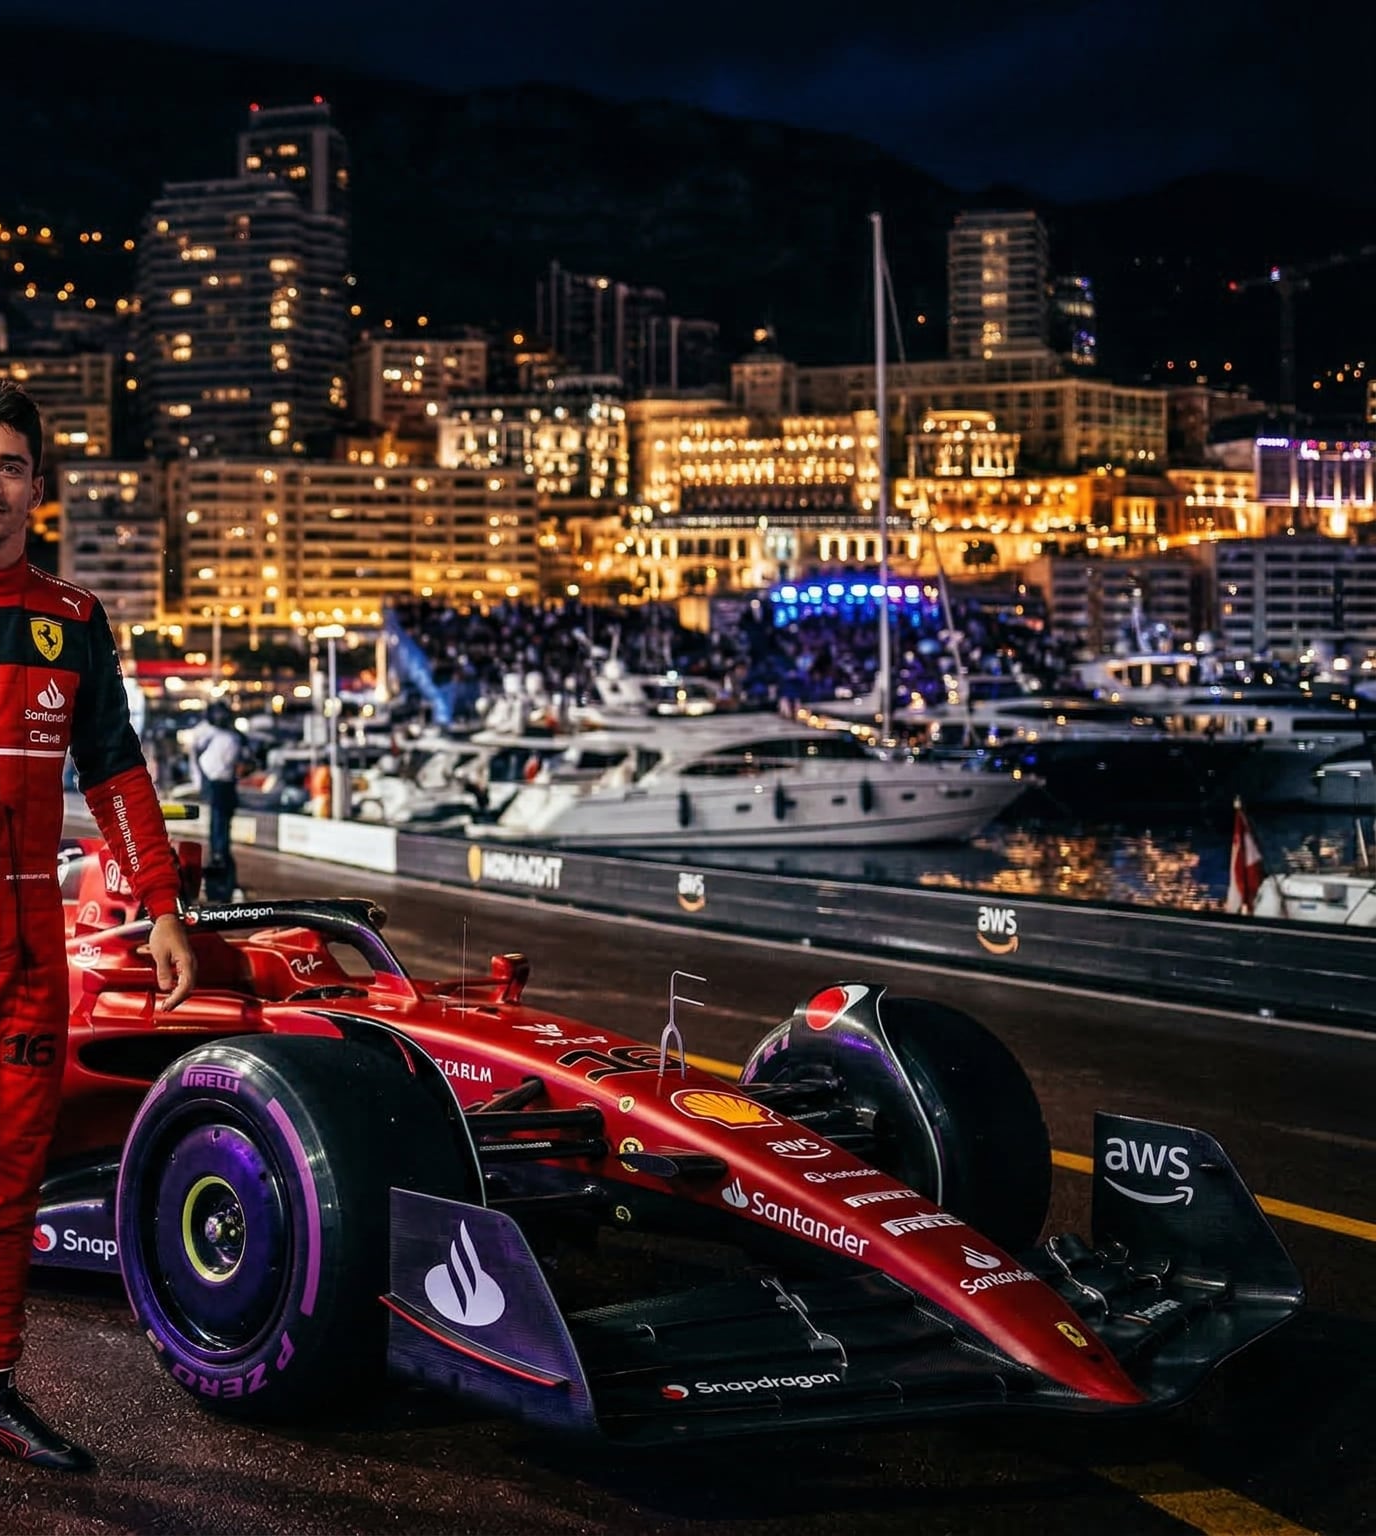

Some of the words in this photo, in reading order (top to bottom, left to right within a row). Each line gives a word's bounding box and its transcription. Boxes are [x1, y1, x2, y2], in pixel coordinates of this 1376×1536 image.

[201, 907, 274, 922] Snapdragon
[978, 906, 1017, 935] aws
[3, 1032, 56, 1067] 16
[766, 1138, 820, 1153] aws
[1105, 1137, 1190, 1180] aws
[751, 1192, 870, 1256] Santander
[172, 1363, 267, 1399] ZERO
[695, 1373, 841, 1393] Snapdragon
